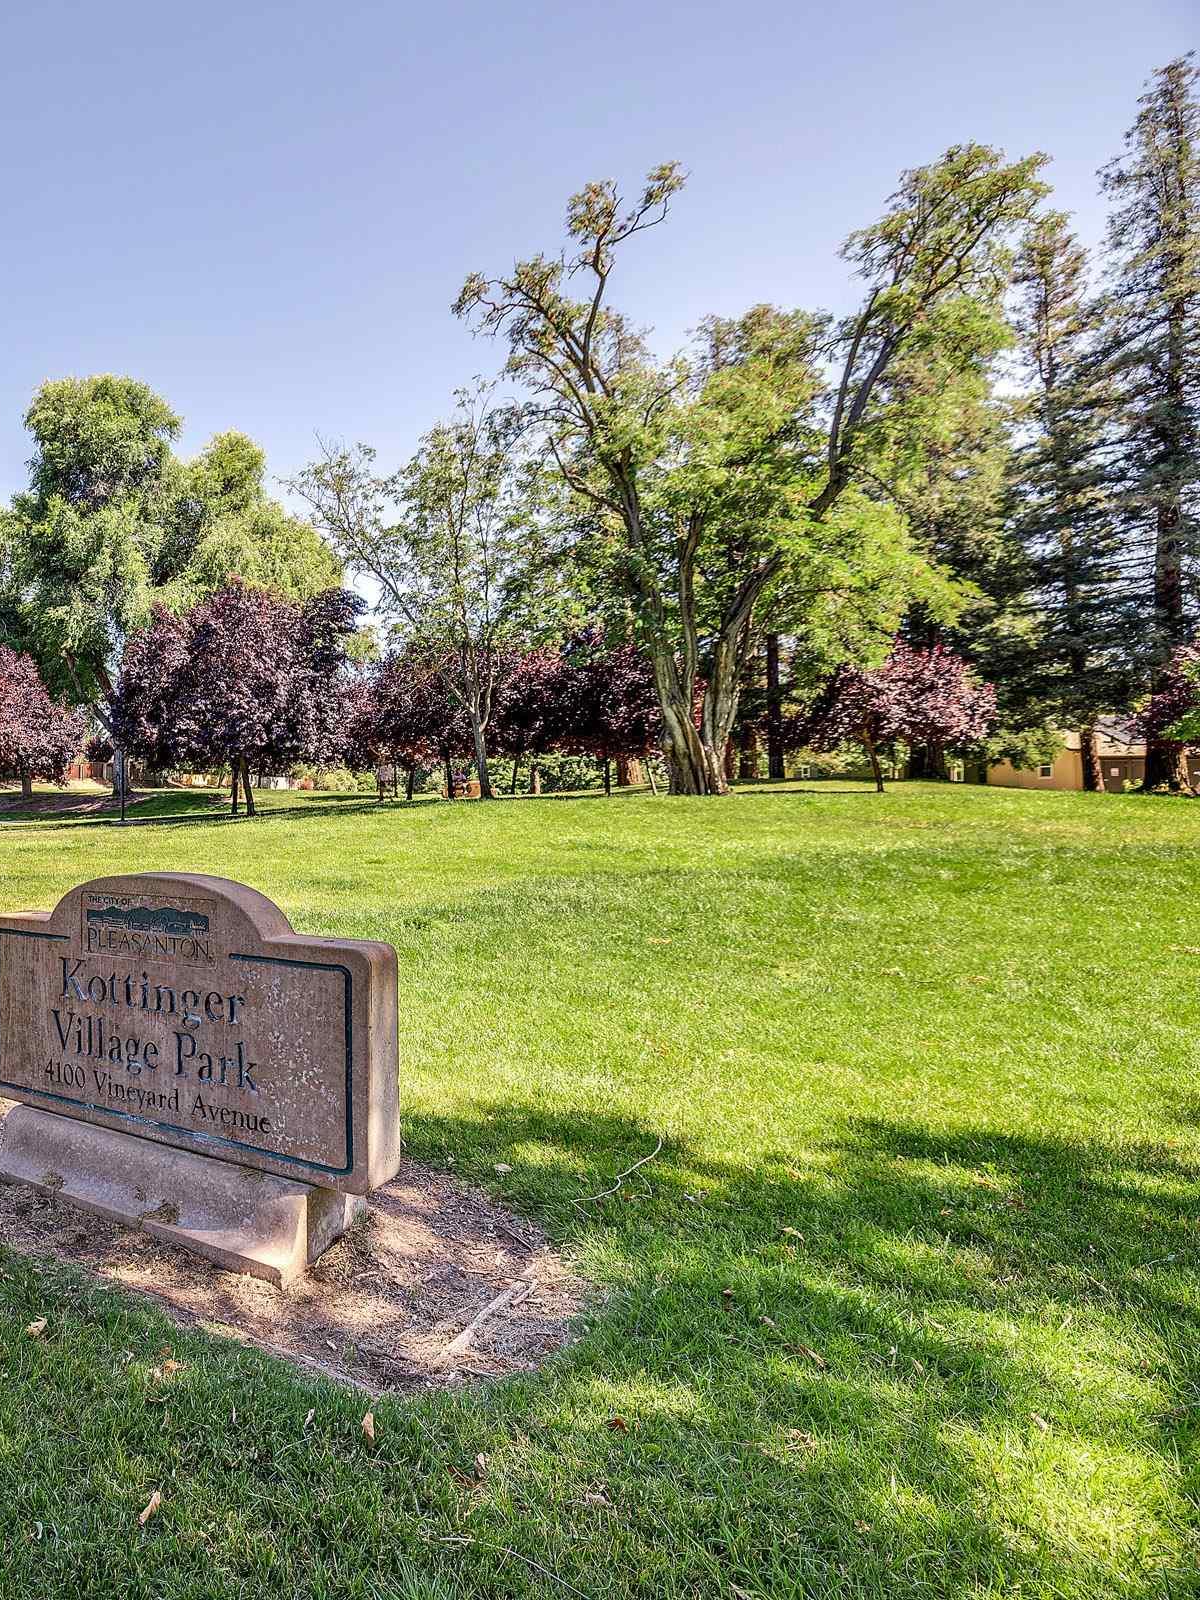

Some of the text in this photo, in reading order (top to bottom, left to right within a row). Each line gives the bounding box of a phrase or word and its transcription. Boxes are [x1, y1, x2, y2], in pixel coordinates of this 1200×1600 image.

[88, 895, 131, 906] THE CITY OF
[59, 956, 245, 1030] Kottinger
[51, 1008, 259, 1095] Village Park
[44, 1058, 272, 1134] 4100 Vineyard Avenue
